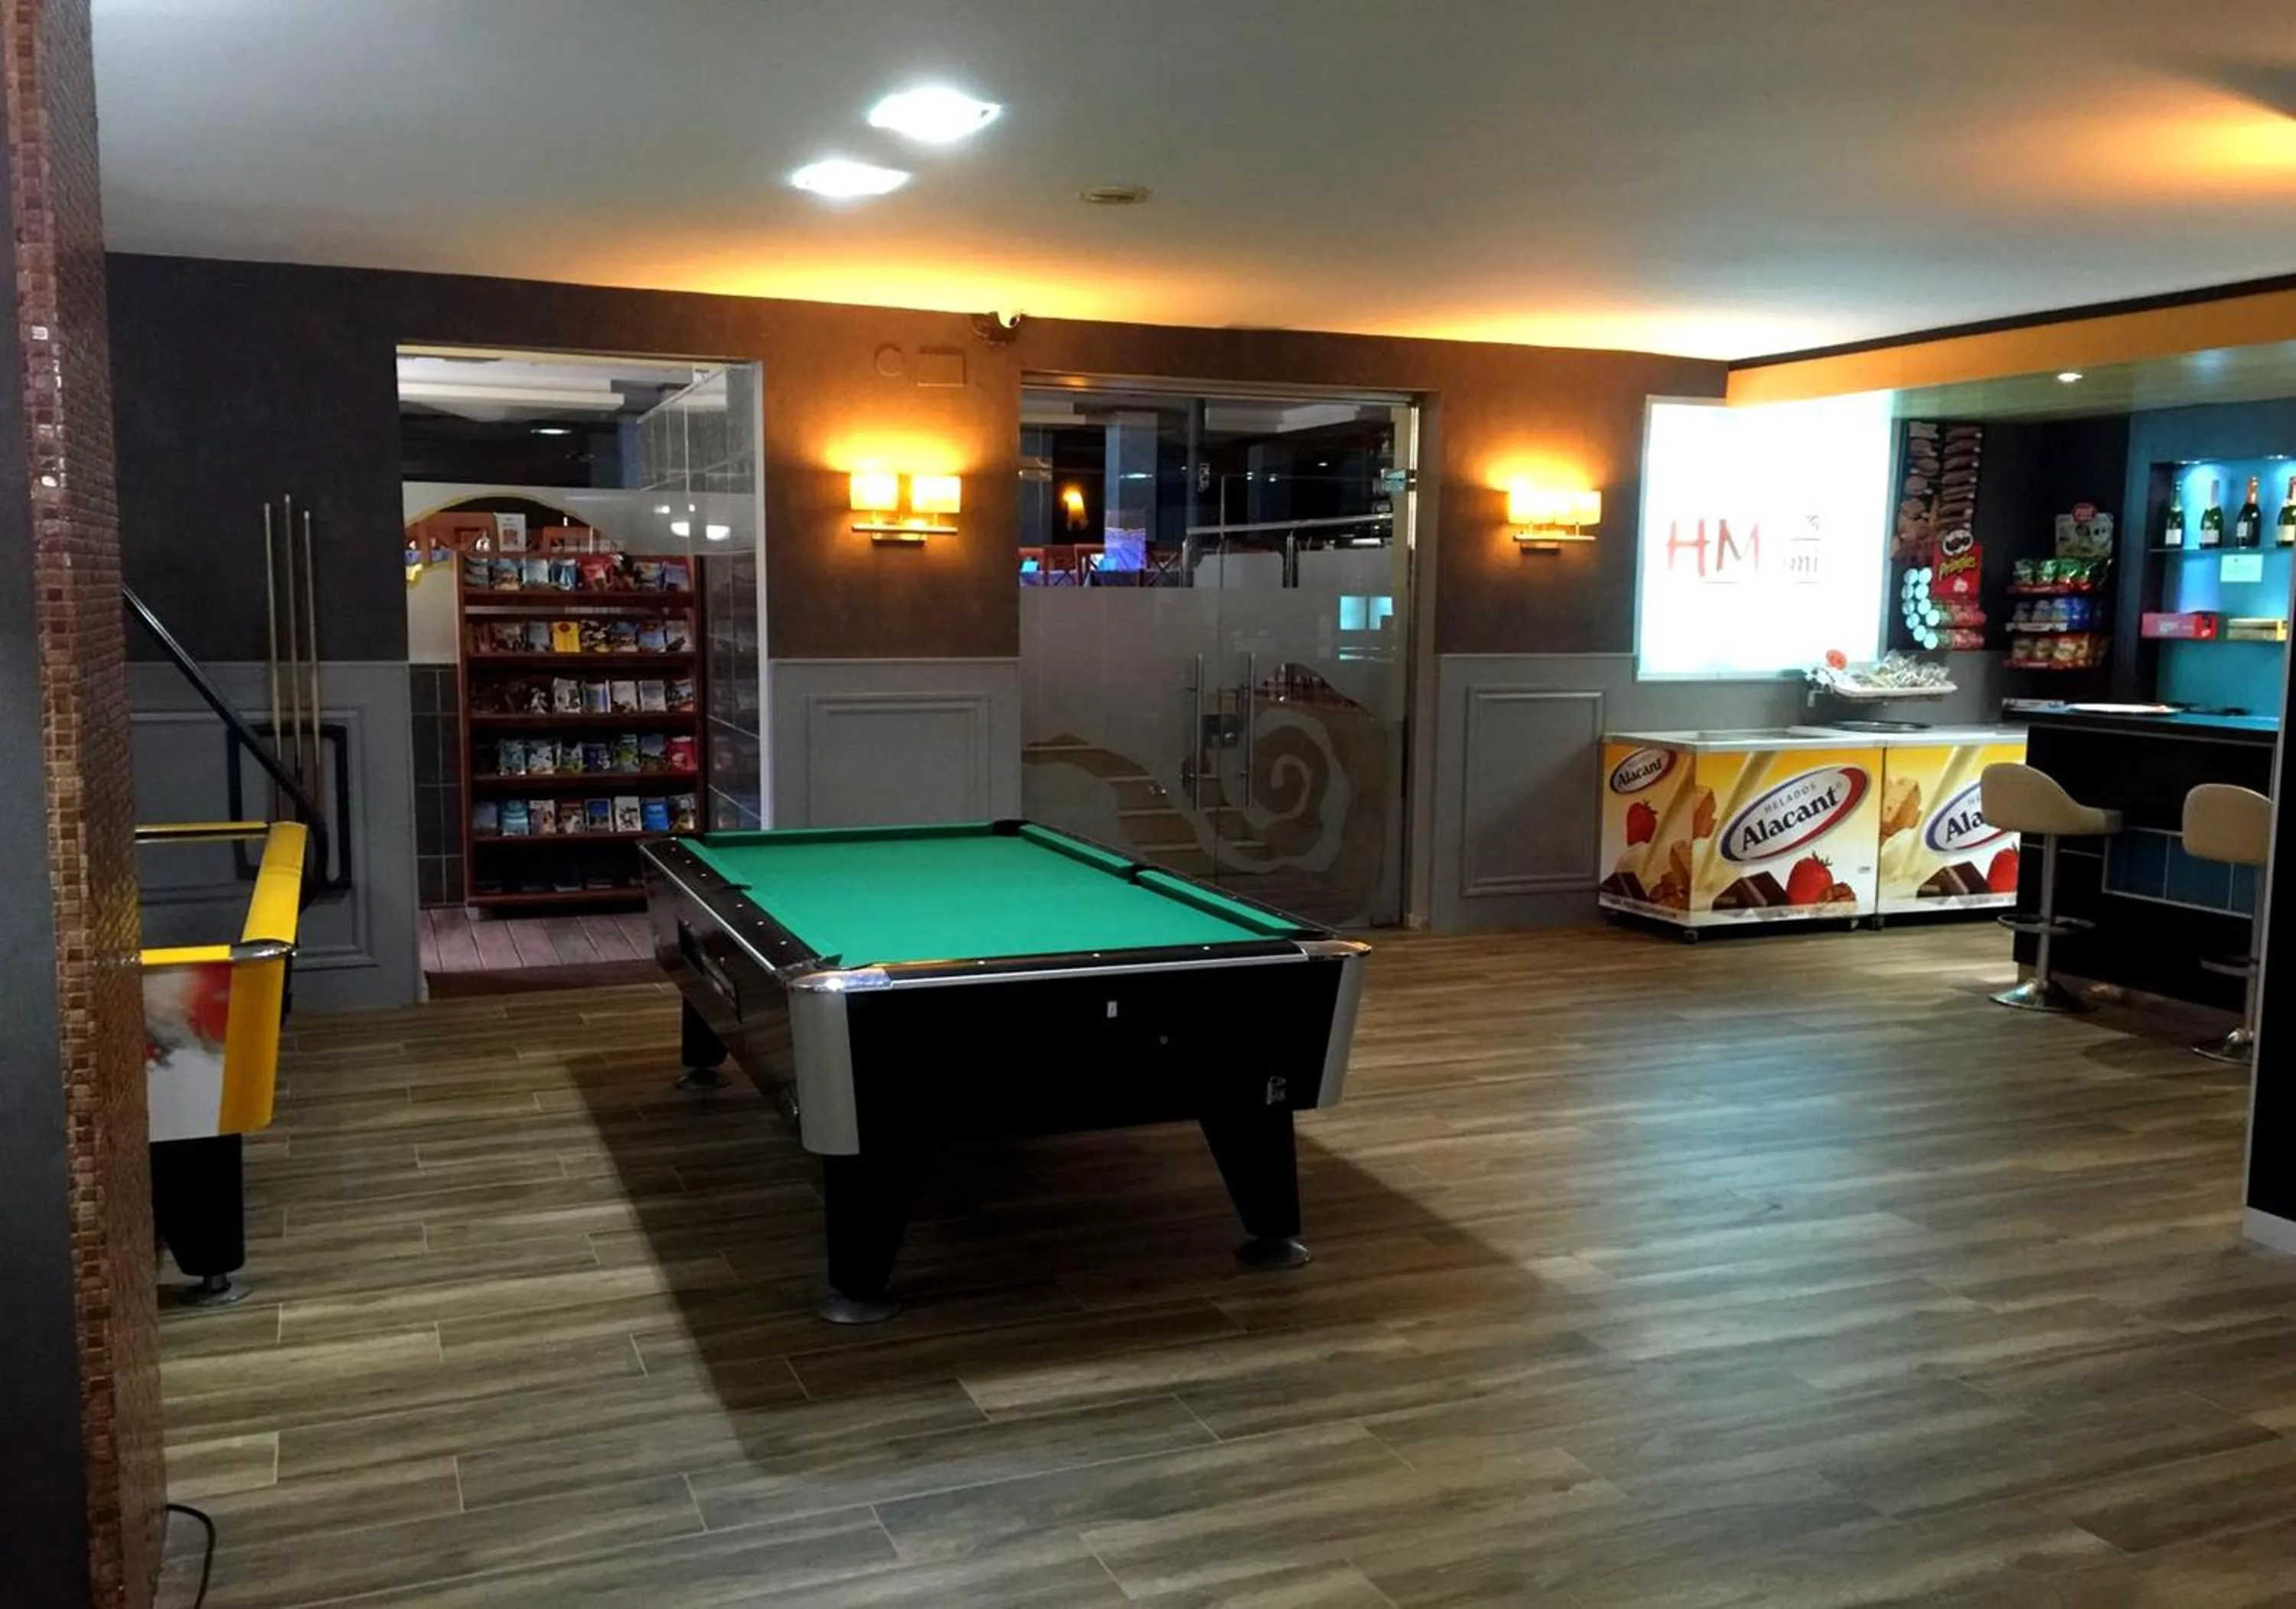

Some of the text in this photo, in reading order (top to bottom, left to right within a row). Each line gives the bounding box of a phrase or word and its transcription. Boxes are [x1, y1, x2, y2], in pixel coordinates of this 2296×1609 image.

[1666, 518, 1760, 578] HM
[1618, 757, 1662, 788] Alacant
[1741, 785, 1838, 851] Alacant
